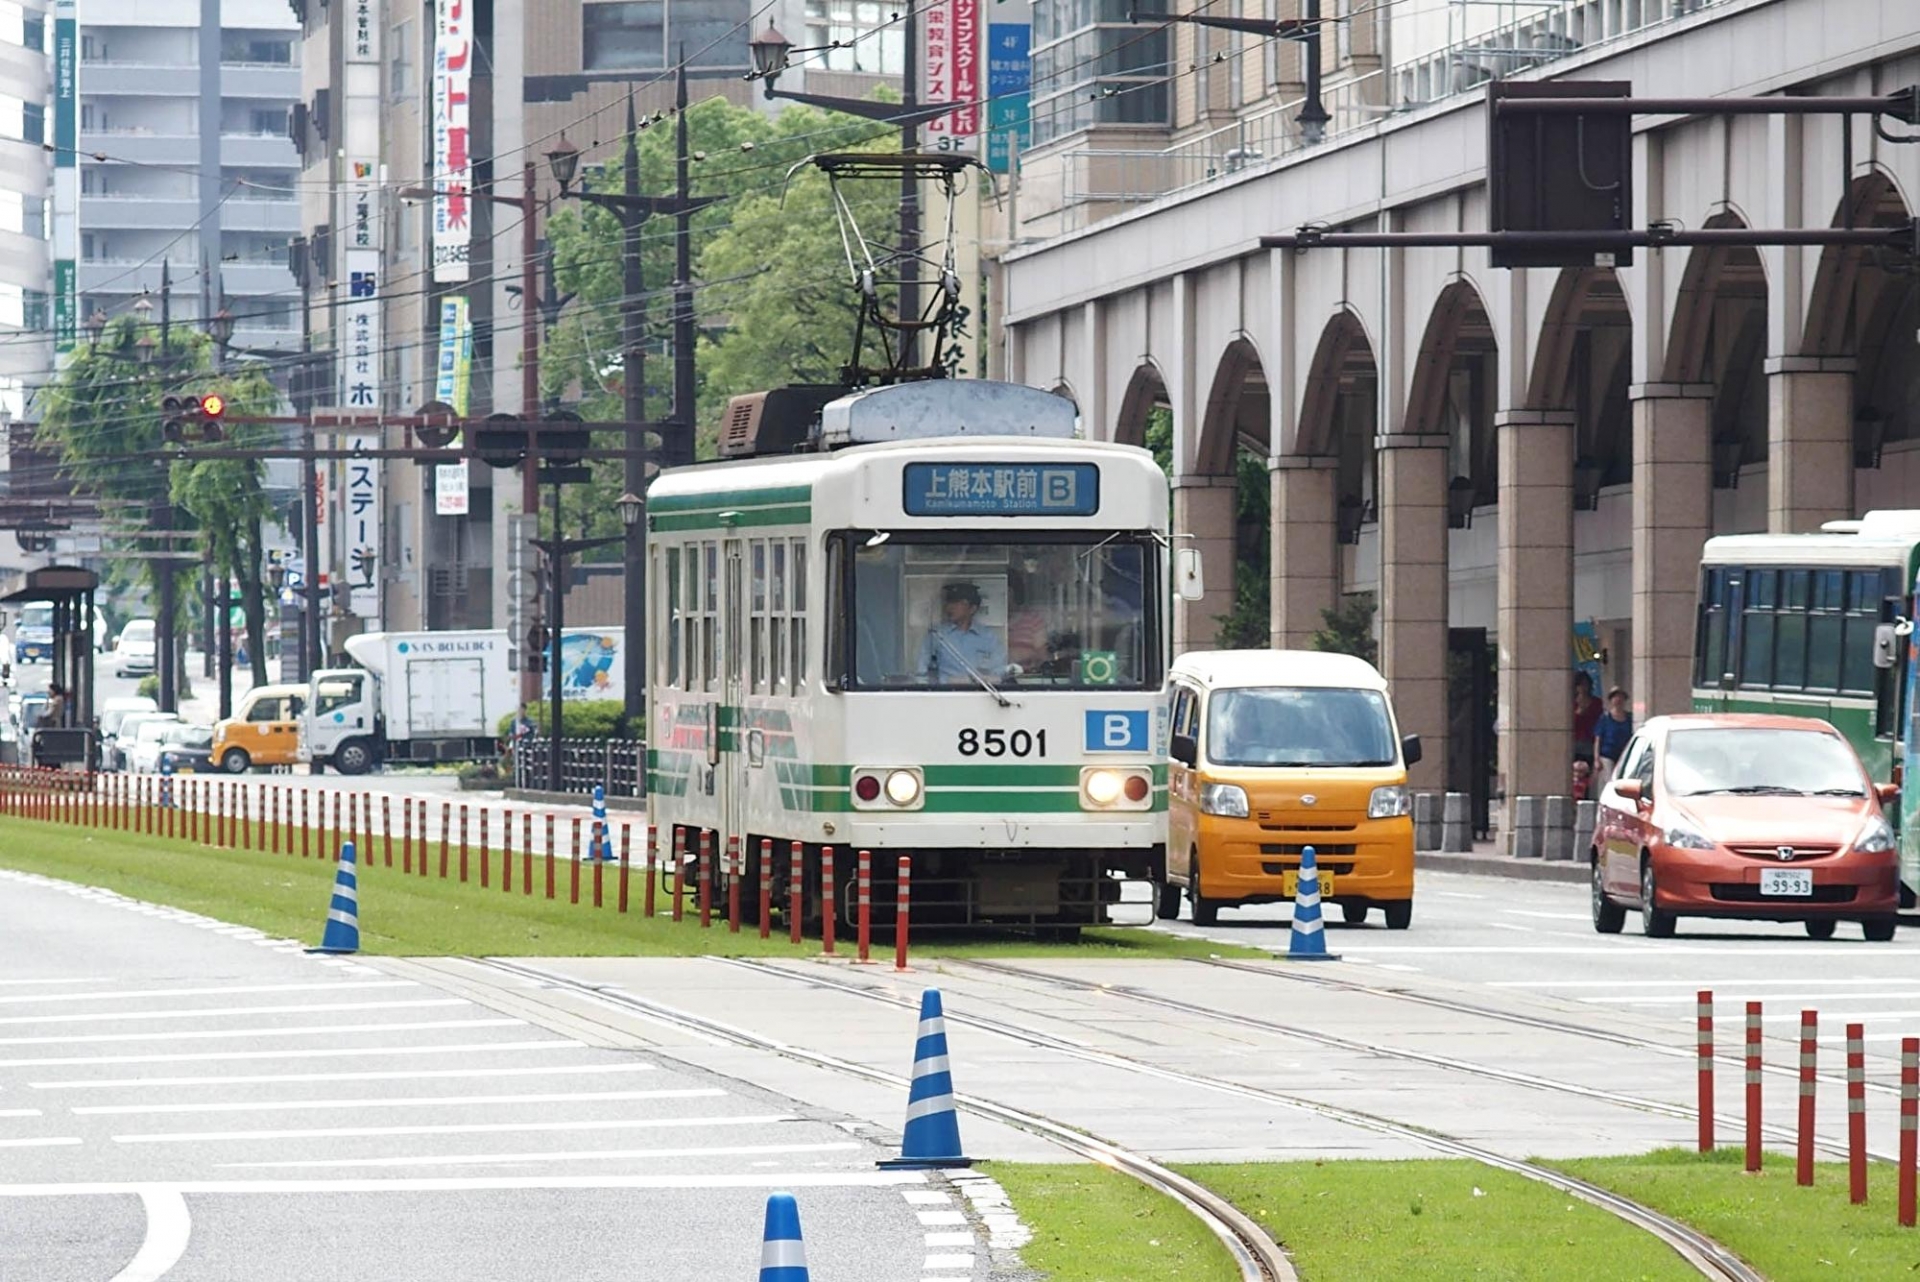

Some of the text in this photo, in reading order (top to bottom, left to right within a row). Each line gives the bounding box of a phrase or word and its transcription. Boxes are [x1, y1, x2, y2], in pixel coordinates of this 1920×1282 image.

[937, 136, 966, 151] 3F
[925, 469, 1038, 499] 上熊本駅前
[1050, 475, 1070, 501] B
[1003, 498, 1037, 509] Station
[957, 728, 1047, 757] 8501
[1104, 714, 1132, 747] B
[1773, 880, 1809, 893] 99-93
